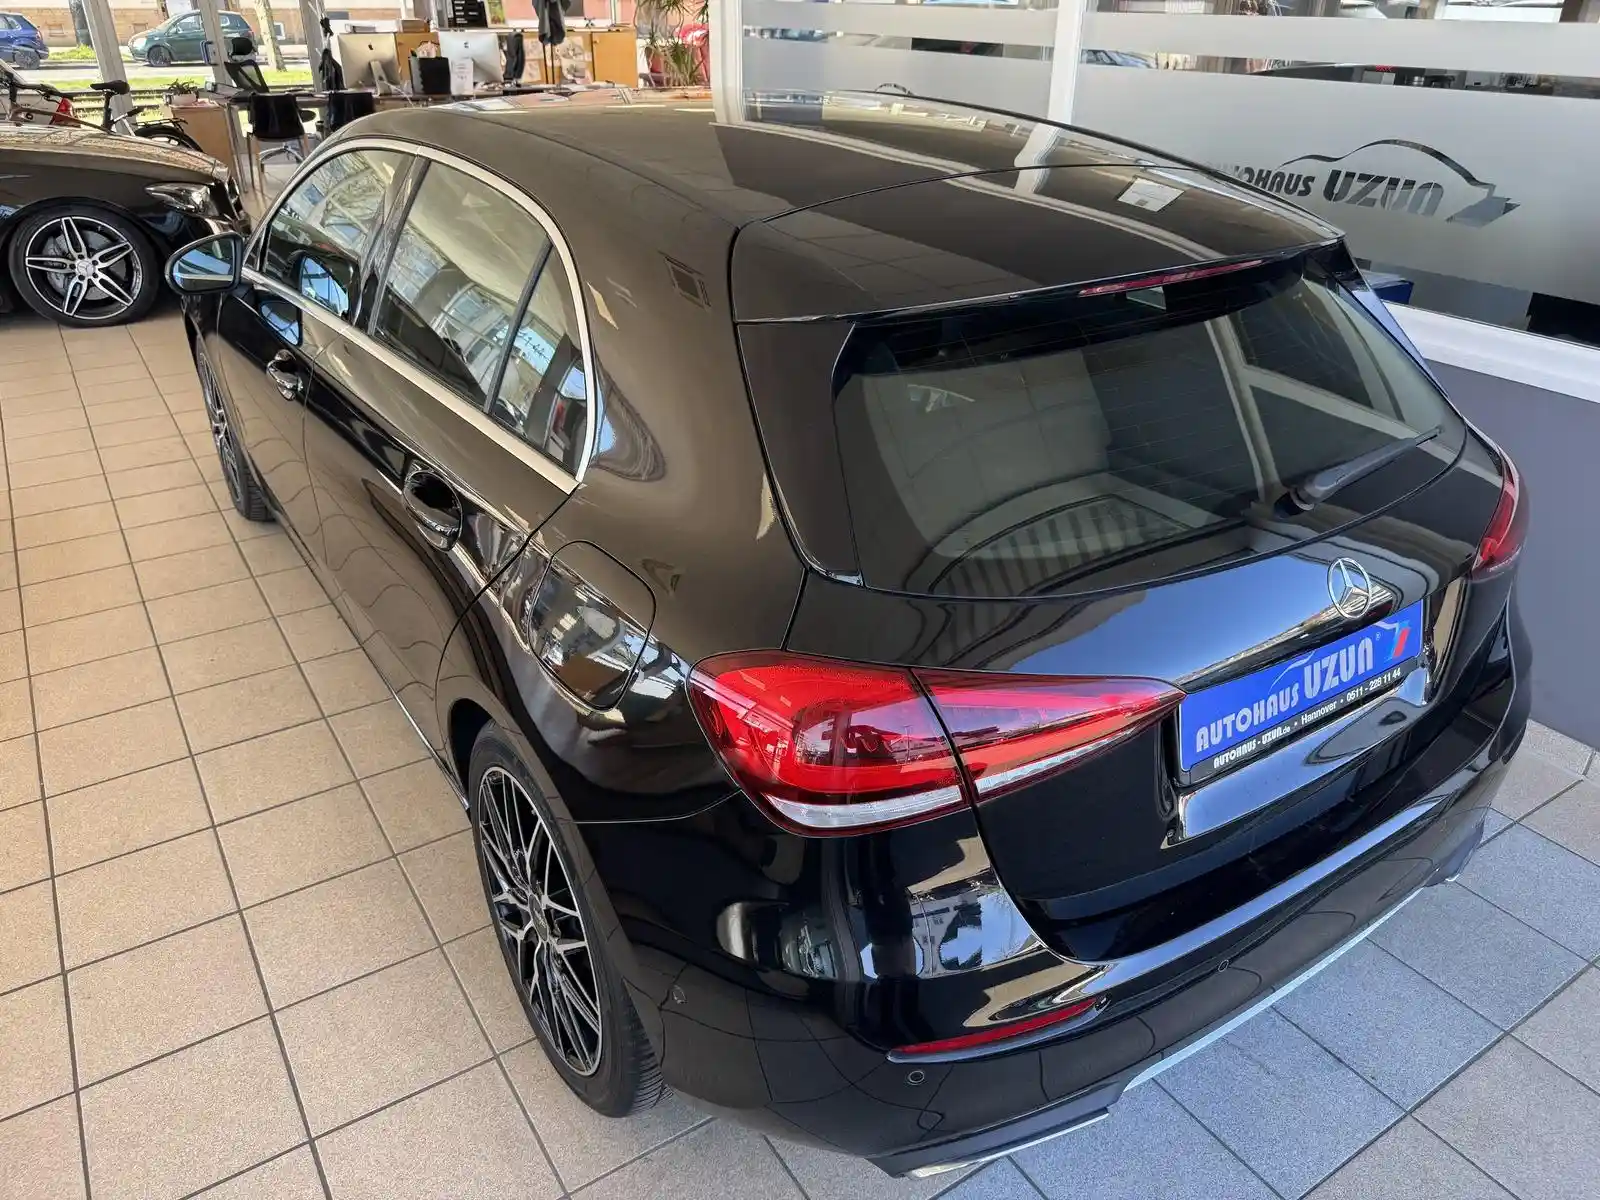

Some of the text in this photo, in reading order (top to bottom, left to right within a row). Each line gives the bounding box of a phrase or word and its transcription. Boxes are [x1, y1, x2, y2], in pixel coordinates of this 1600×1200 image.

[1322, 169, 1445, 217] UZUN
[1196, 637, 1373, 753] AUTOHAUS UZUN
[1213, 738, 1257, 768] AUTOHAUS
[1301, 701, 1338, 725] Hannover
[1346, 686, 1364, 702] 0511
[1383, 671, 1391, 684] 11
[1392, 667, 1401, 680] 44
